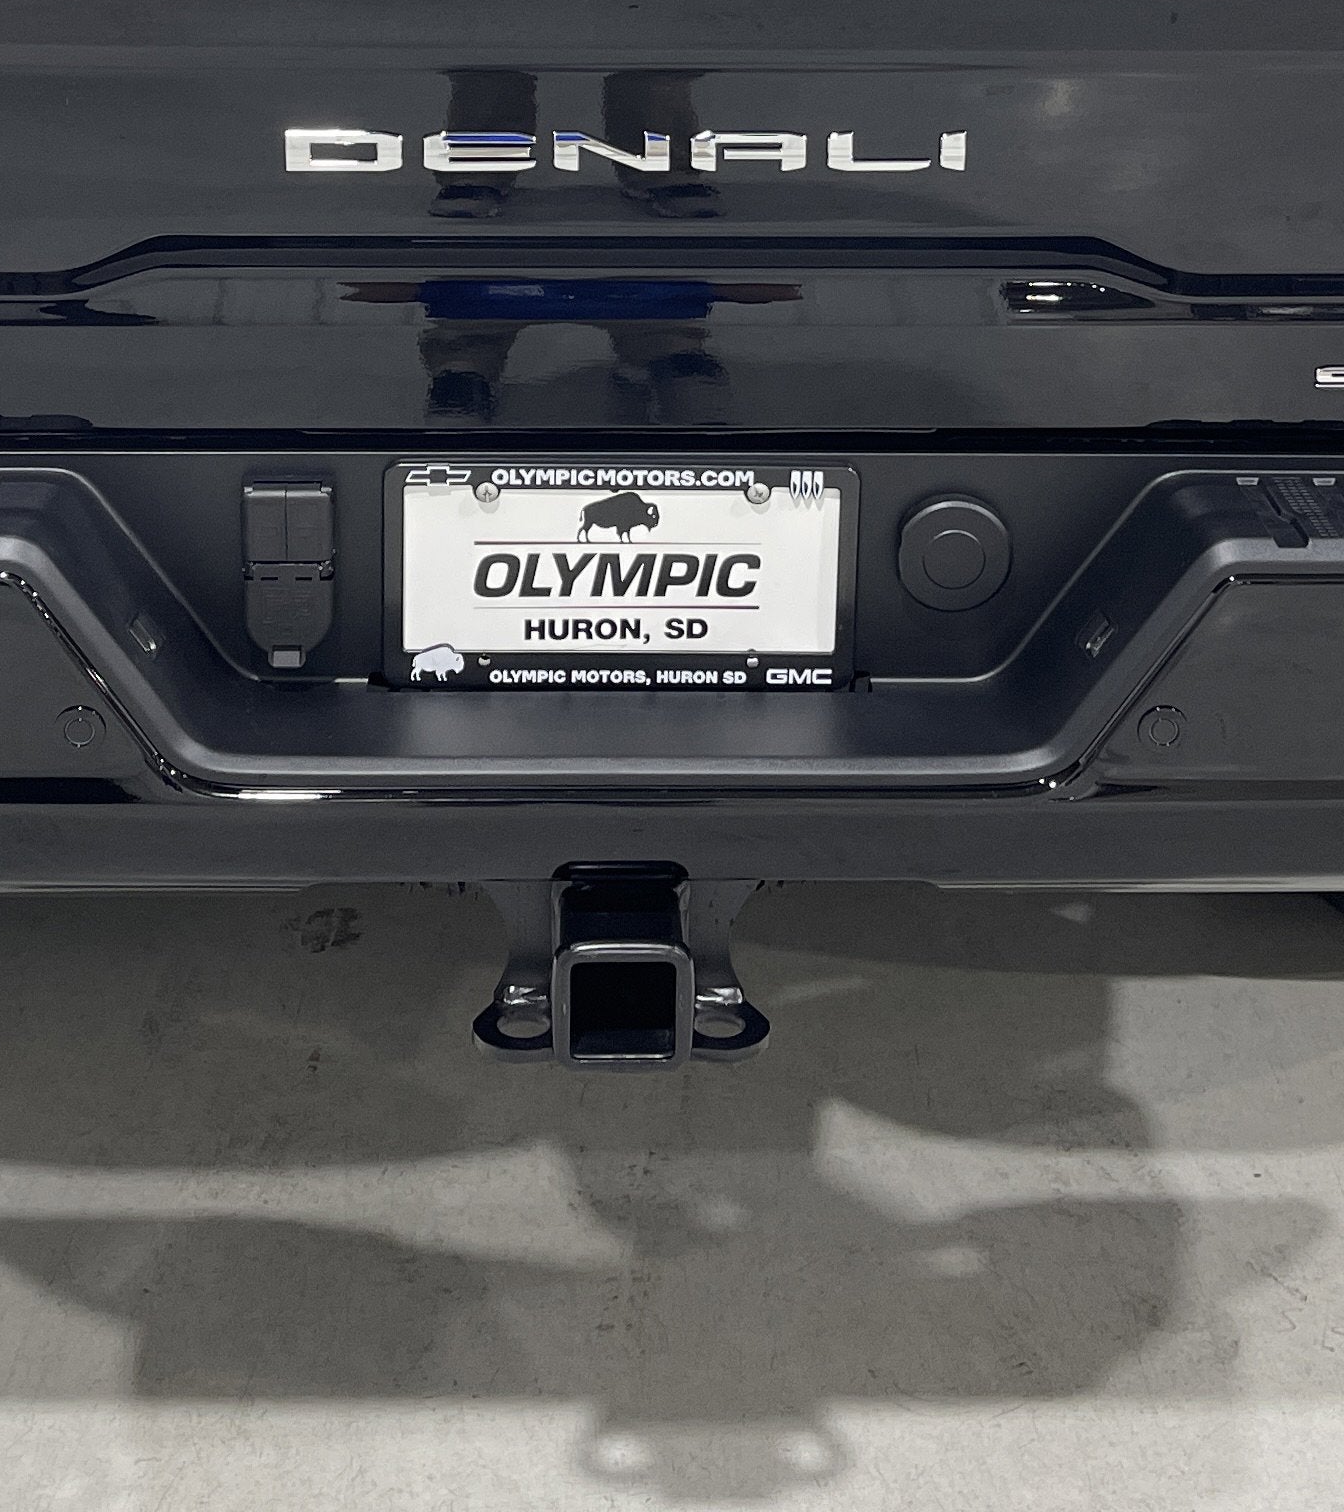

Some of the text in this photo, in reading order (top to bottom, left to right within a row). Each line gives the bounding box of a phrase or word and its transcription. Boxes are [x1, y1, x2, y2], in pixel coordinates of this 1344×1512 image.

[284, 129, 967, 172] DENALI
[491, 468, 755, 487] OLYMPICMOTORS.COM
[473, 553, 761, 598] OLYMPIC
[524, 618, 709, 644] HURON, SD
[489, 669, 747, 686] OLYMPIC MOTORS, HURON SD
[766, 668, 833, 685] GMC
